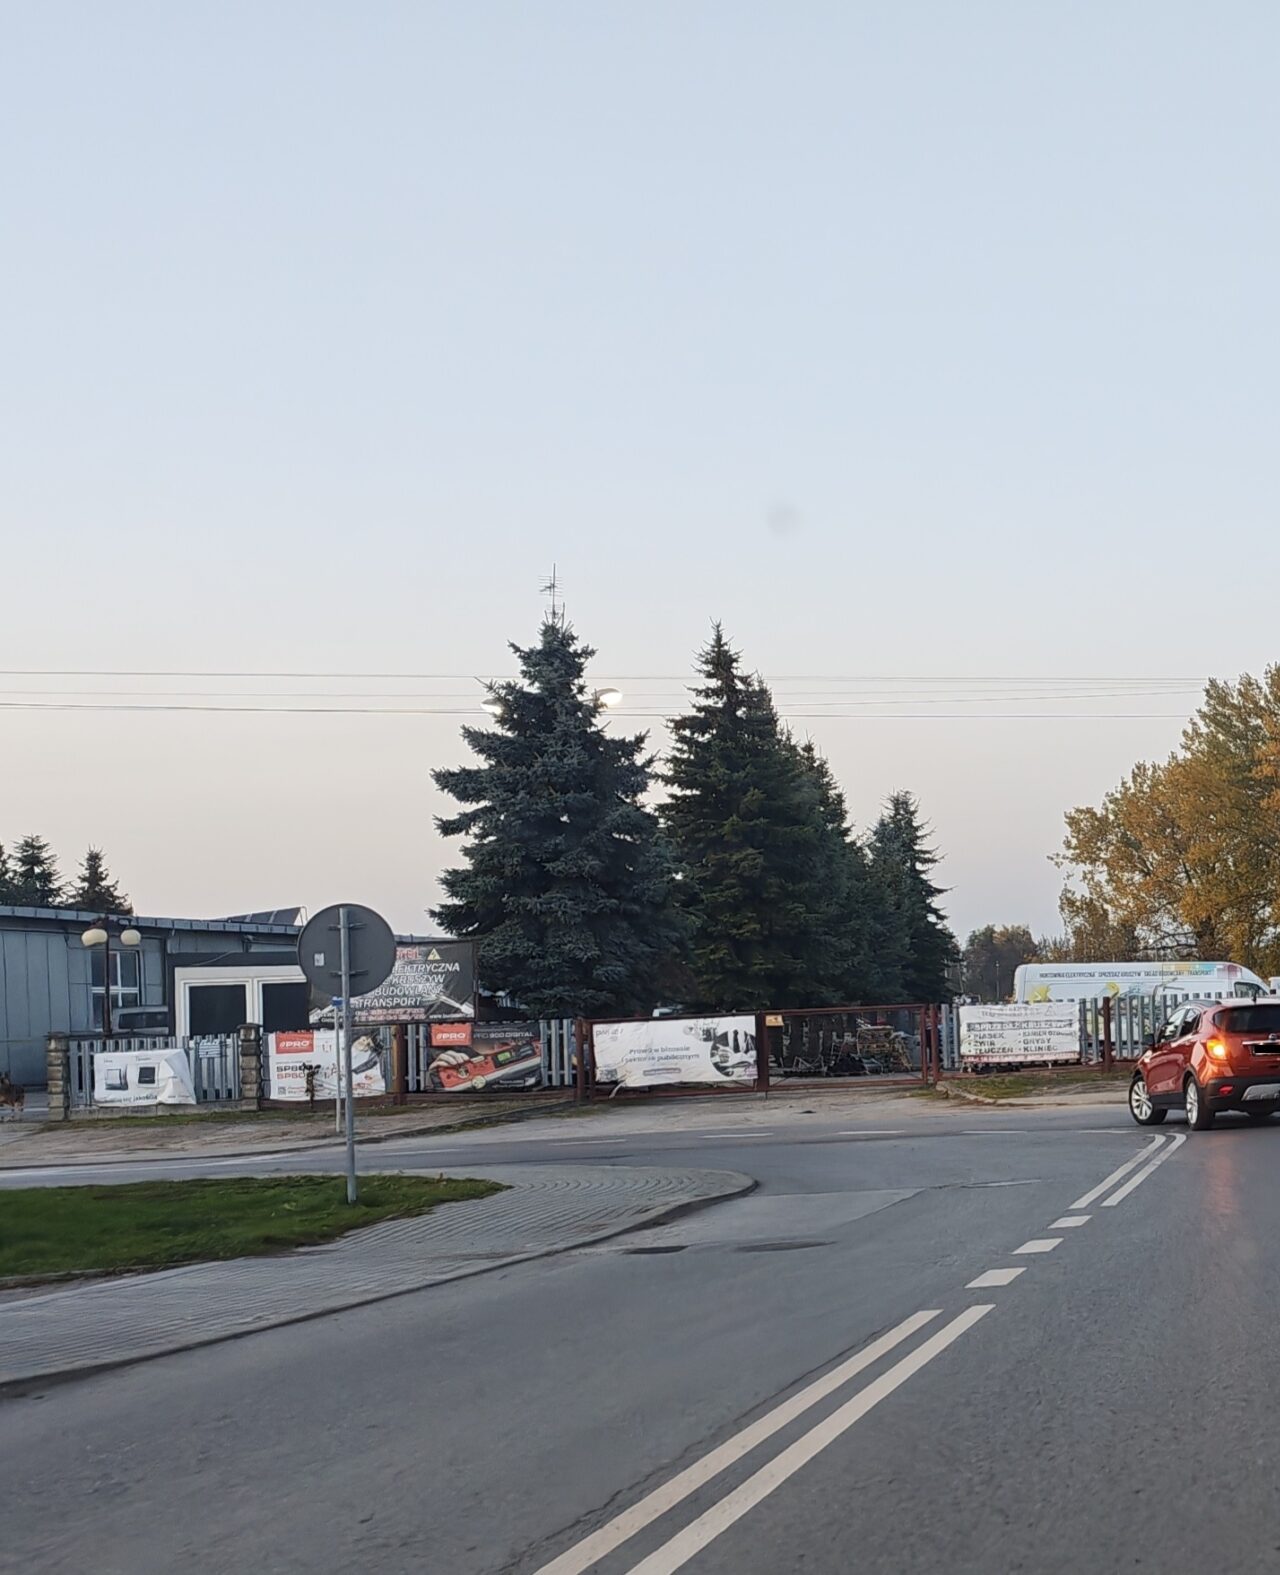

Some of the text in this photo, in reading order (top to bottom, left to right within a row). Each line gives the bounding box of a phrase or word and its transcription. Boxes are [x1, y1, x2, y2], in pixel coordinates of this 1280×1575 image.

[392, 962, 460, 974] LEKTRYCZNA
[392, 974, 446, 985] KRUSZYW
[358, 997, 422, 1008] TRANSPORT
